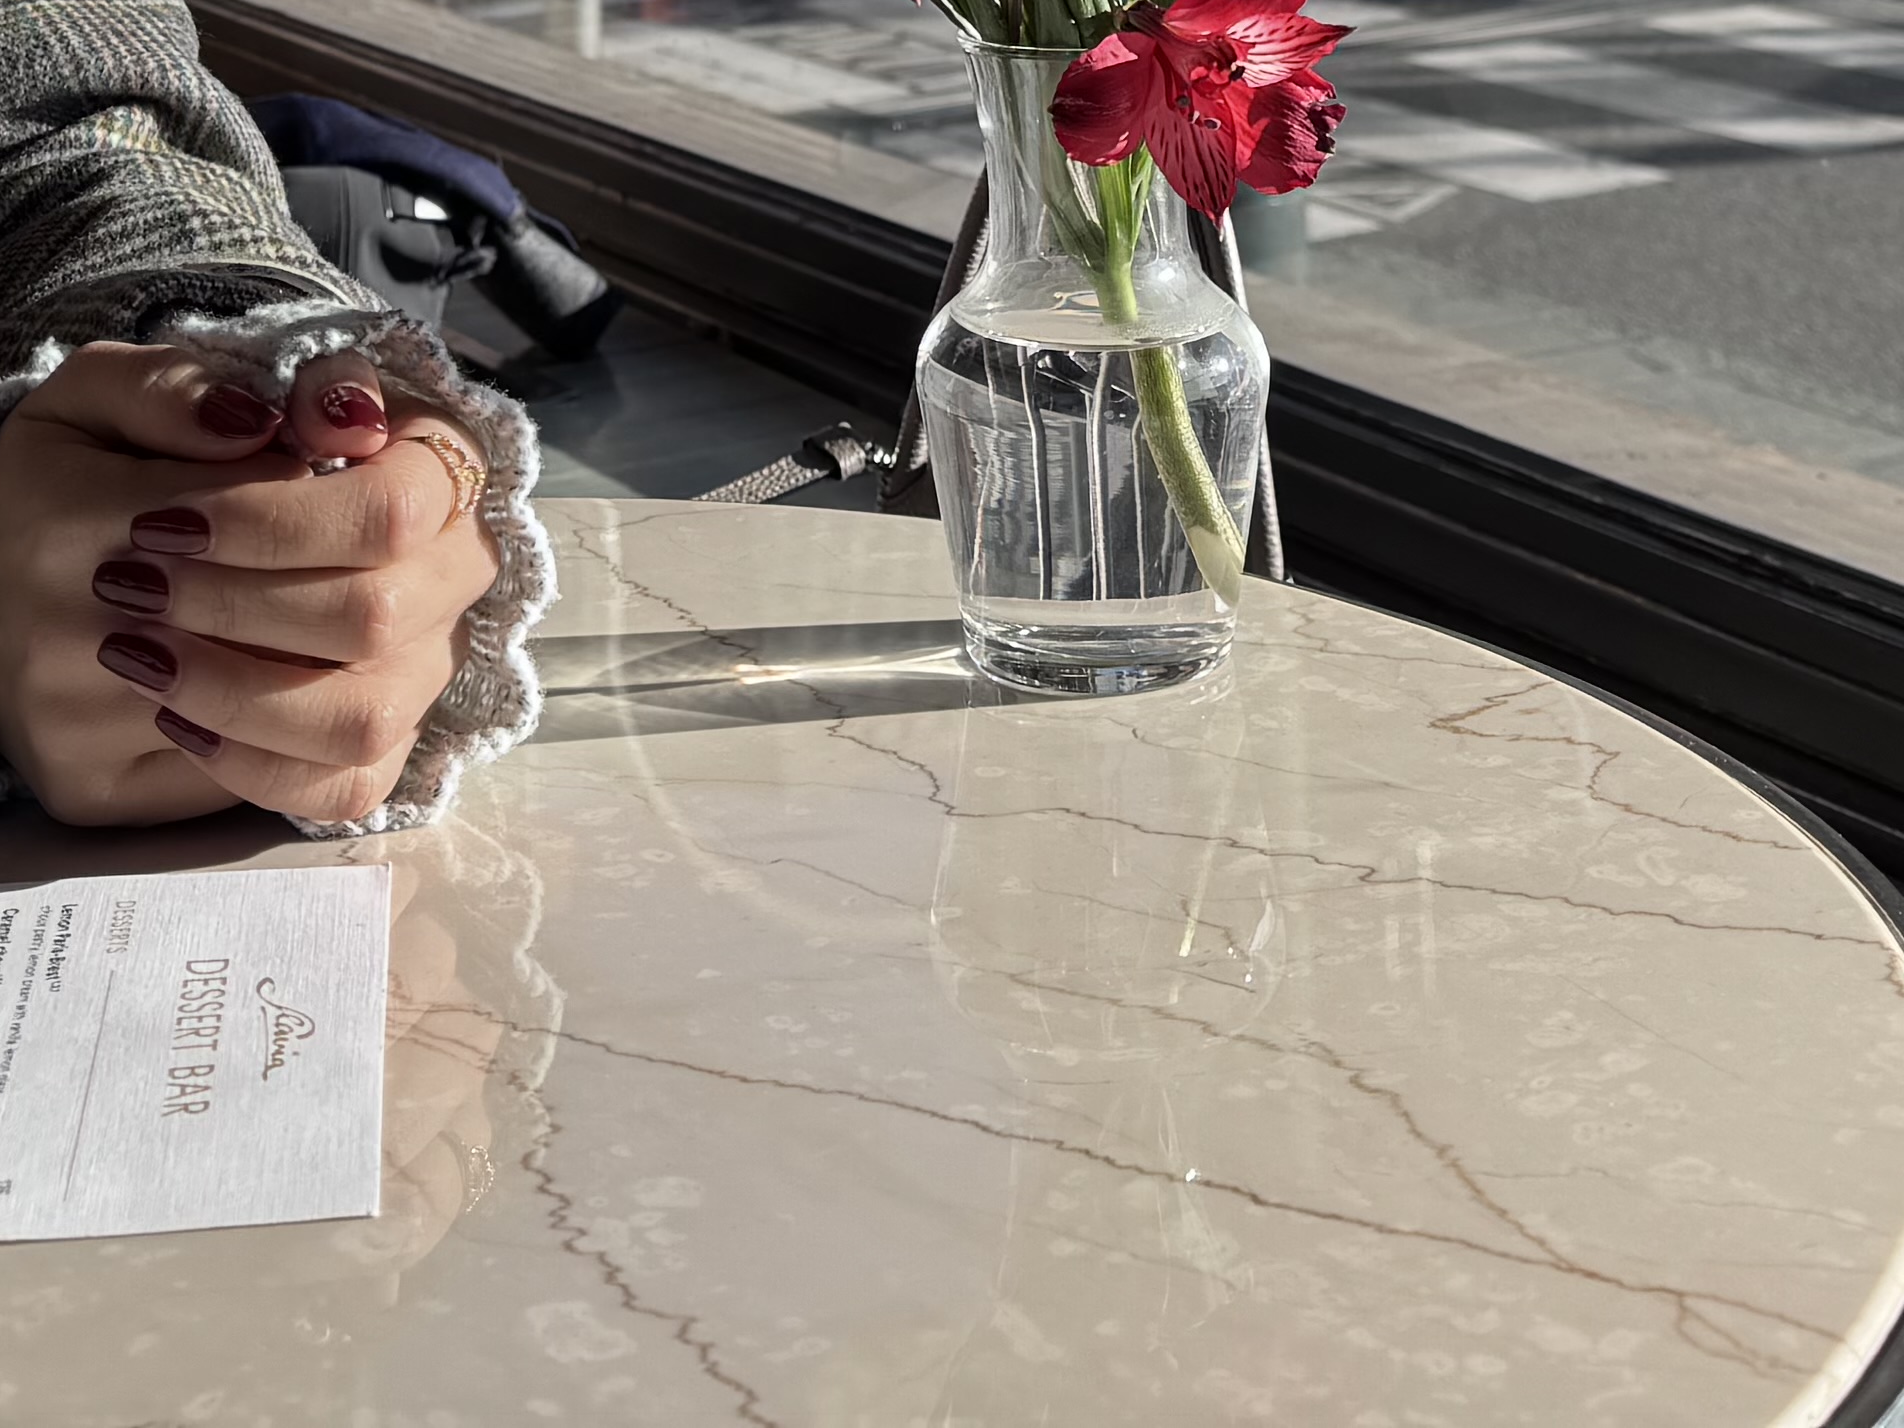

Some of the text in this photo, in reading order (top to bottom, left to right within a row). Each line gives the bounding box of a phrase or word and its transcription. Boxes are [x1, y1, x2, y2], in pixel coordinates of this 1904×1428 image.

[57, 903, 78, 930] Lemon
[104, 900, 136, 954] DESSERTS
[160, 958, 229, 1116] DESSERT BAR
[254, 976, 316, 1081] Slavia
